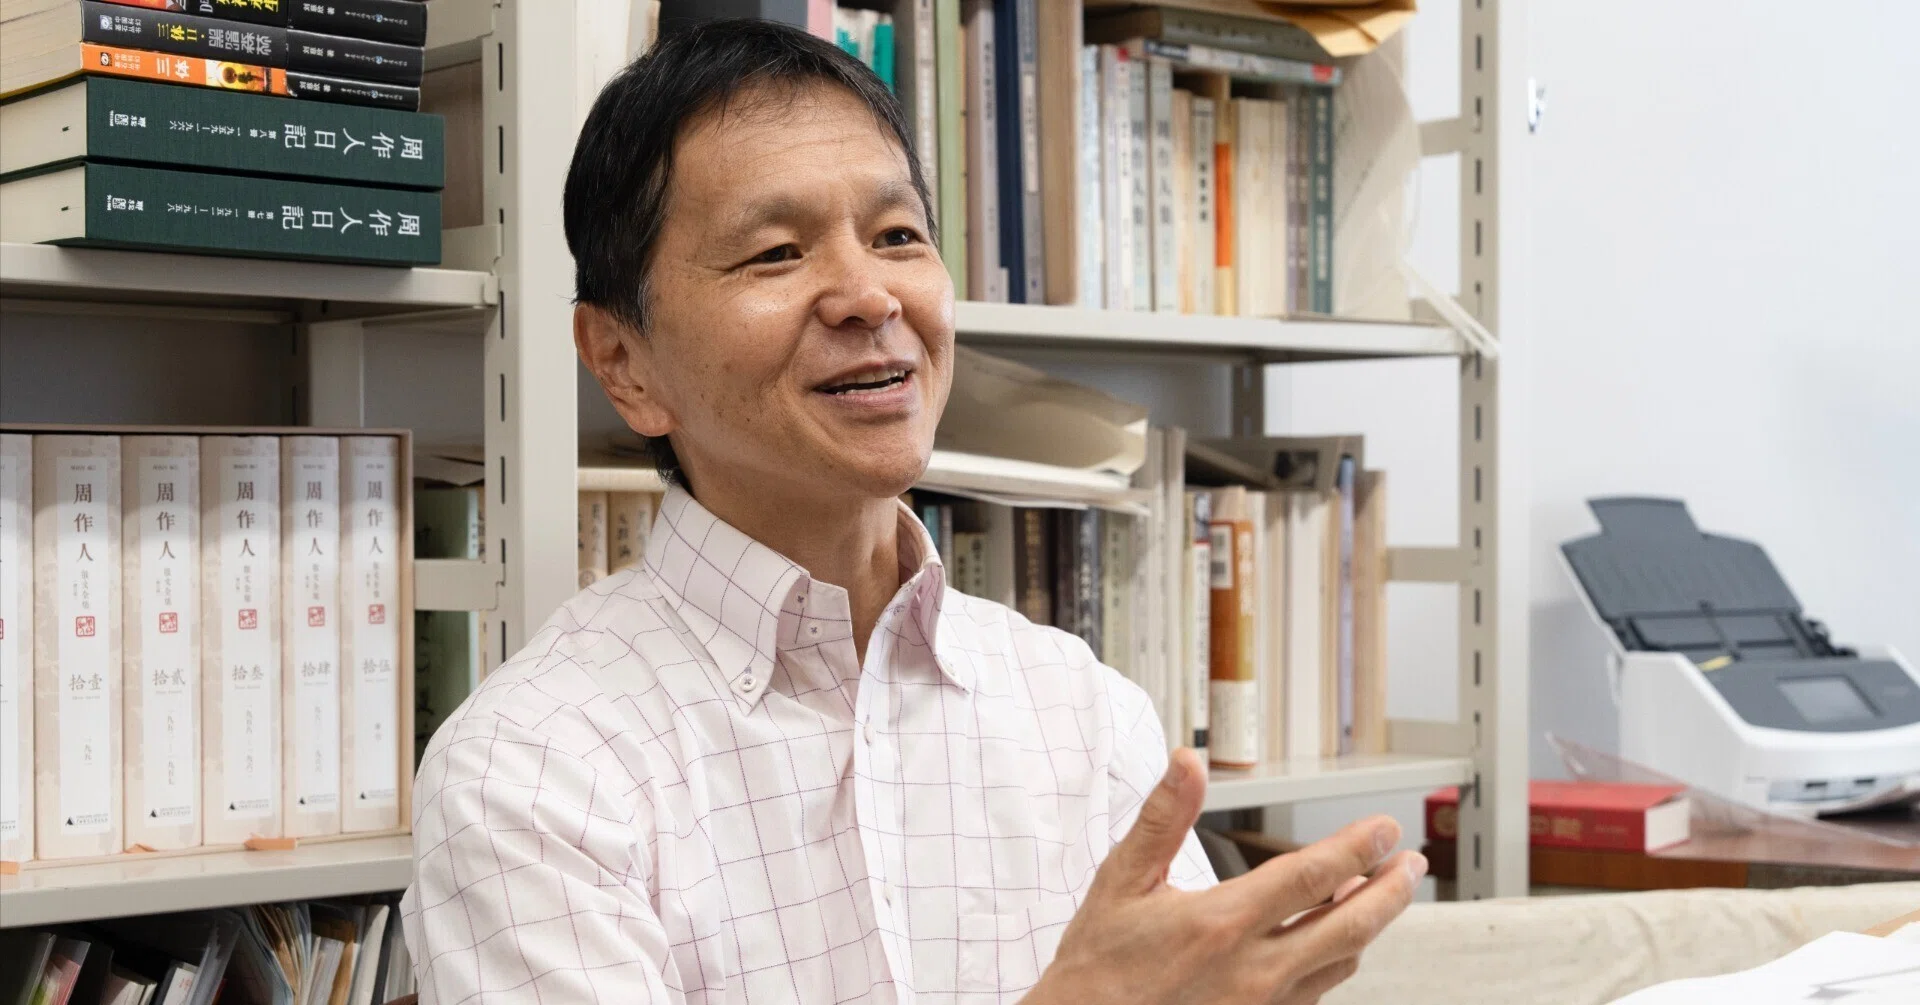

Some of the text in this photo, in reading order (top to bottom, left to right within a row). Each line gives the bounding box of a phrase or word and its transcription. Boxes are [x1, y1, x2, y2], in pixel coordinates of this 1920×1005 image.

[156, 57, 190, 80] 三体
[284, 123, 424, 160] 周作人日記
[281, 205, 421, 237] 周作人日記
[74, 483, 94, 562] 周作人
[156, 482, 176, 560] 周作人
[236, 480, 256, 557] 周作人
[305, 480, 324, 556] 周作人
[367, 480, 384, 555] 周作人
[68, 672, 103, 691] 拾壹
